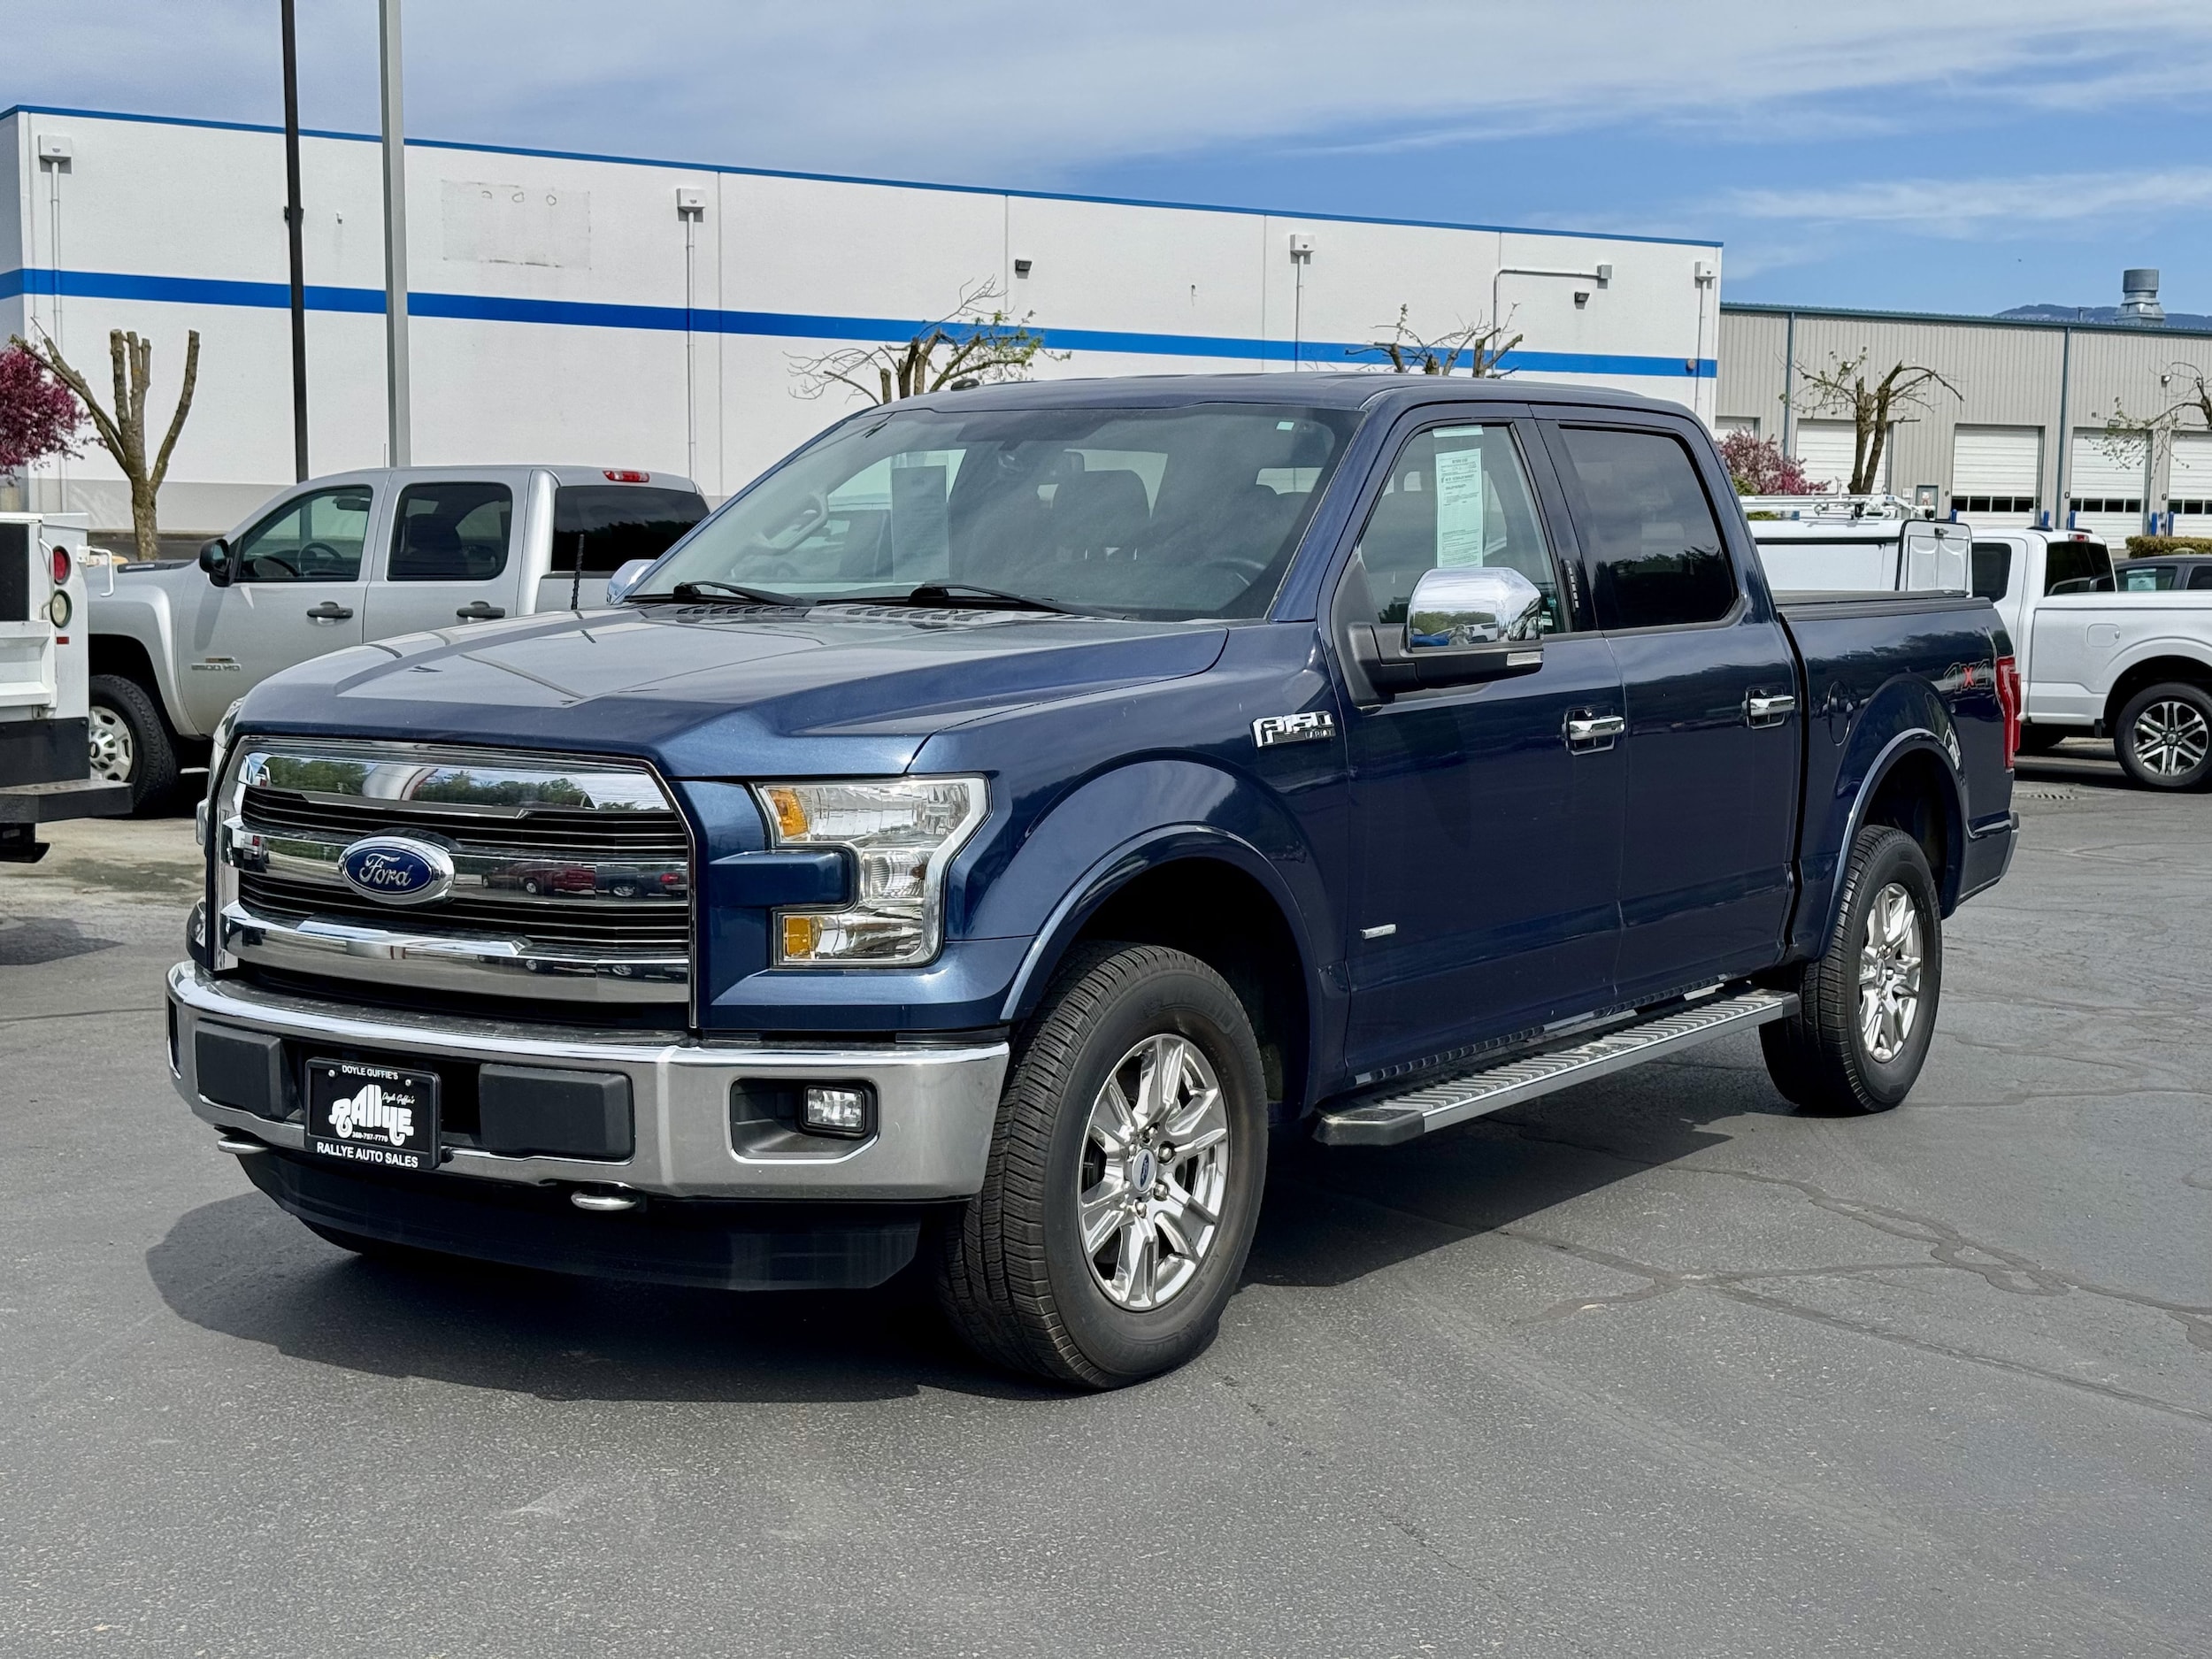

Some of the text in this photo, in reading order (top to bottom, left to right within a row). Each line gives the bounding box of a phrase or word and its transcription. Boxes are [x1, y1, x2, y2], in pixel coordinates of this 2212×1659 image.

[359, 853, 414, 887] Ford
[342, 1064, 399, 1080] DOYLE GUFFIE'S
[317, 1141, 419, 1168] RALLYE AUTO SALES
